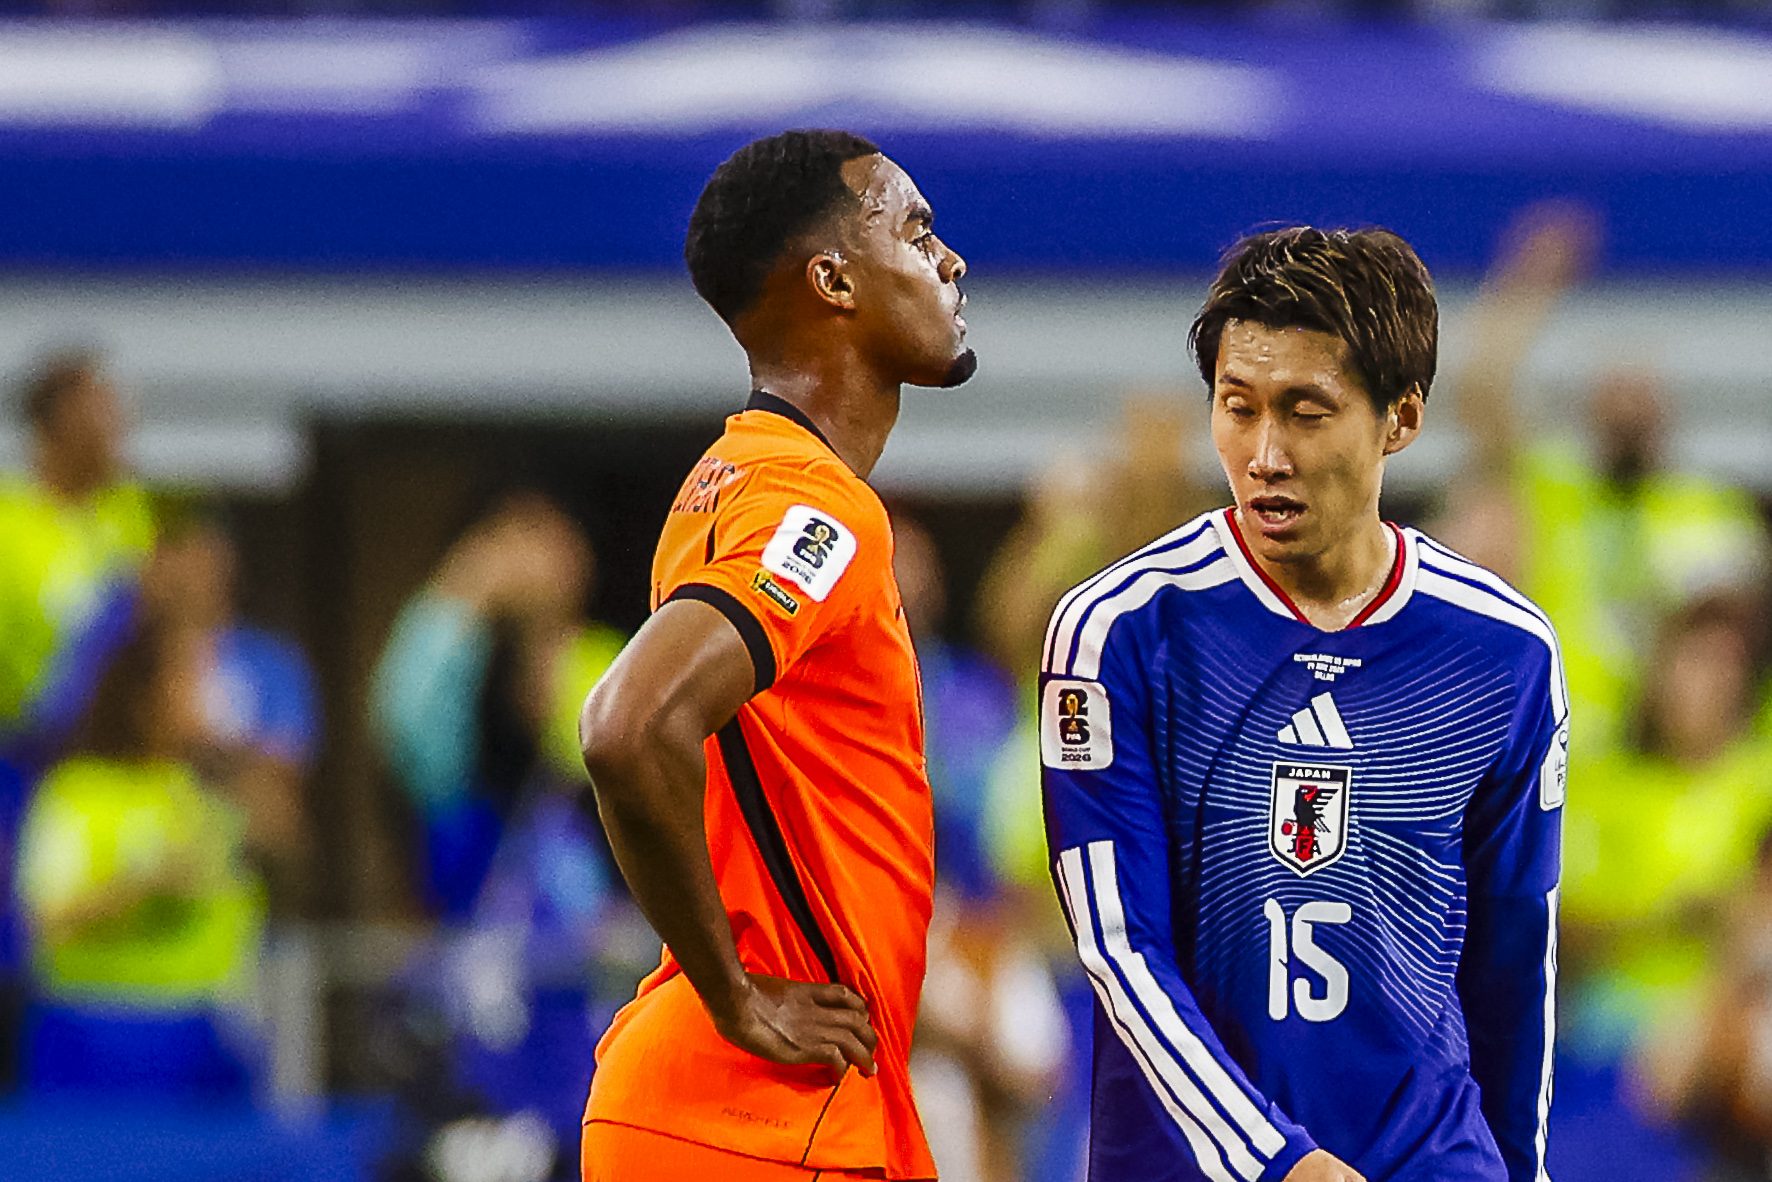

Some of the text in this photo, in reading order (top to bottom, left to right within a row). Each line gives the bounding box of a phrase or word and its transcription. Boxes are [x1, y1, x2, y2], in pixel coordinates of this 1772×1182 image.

[1061, 754, 1091, 762] 2026
[1288, 768, 1331, 780] JAPAN
[1264, 898, 1352, 1022] 15
